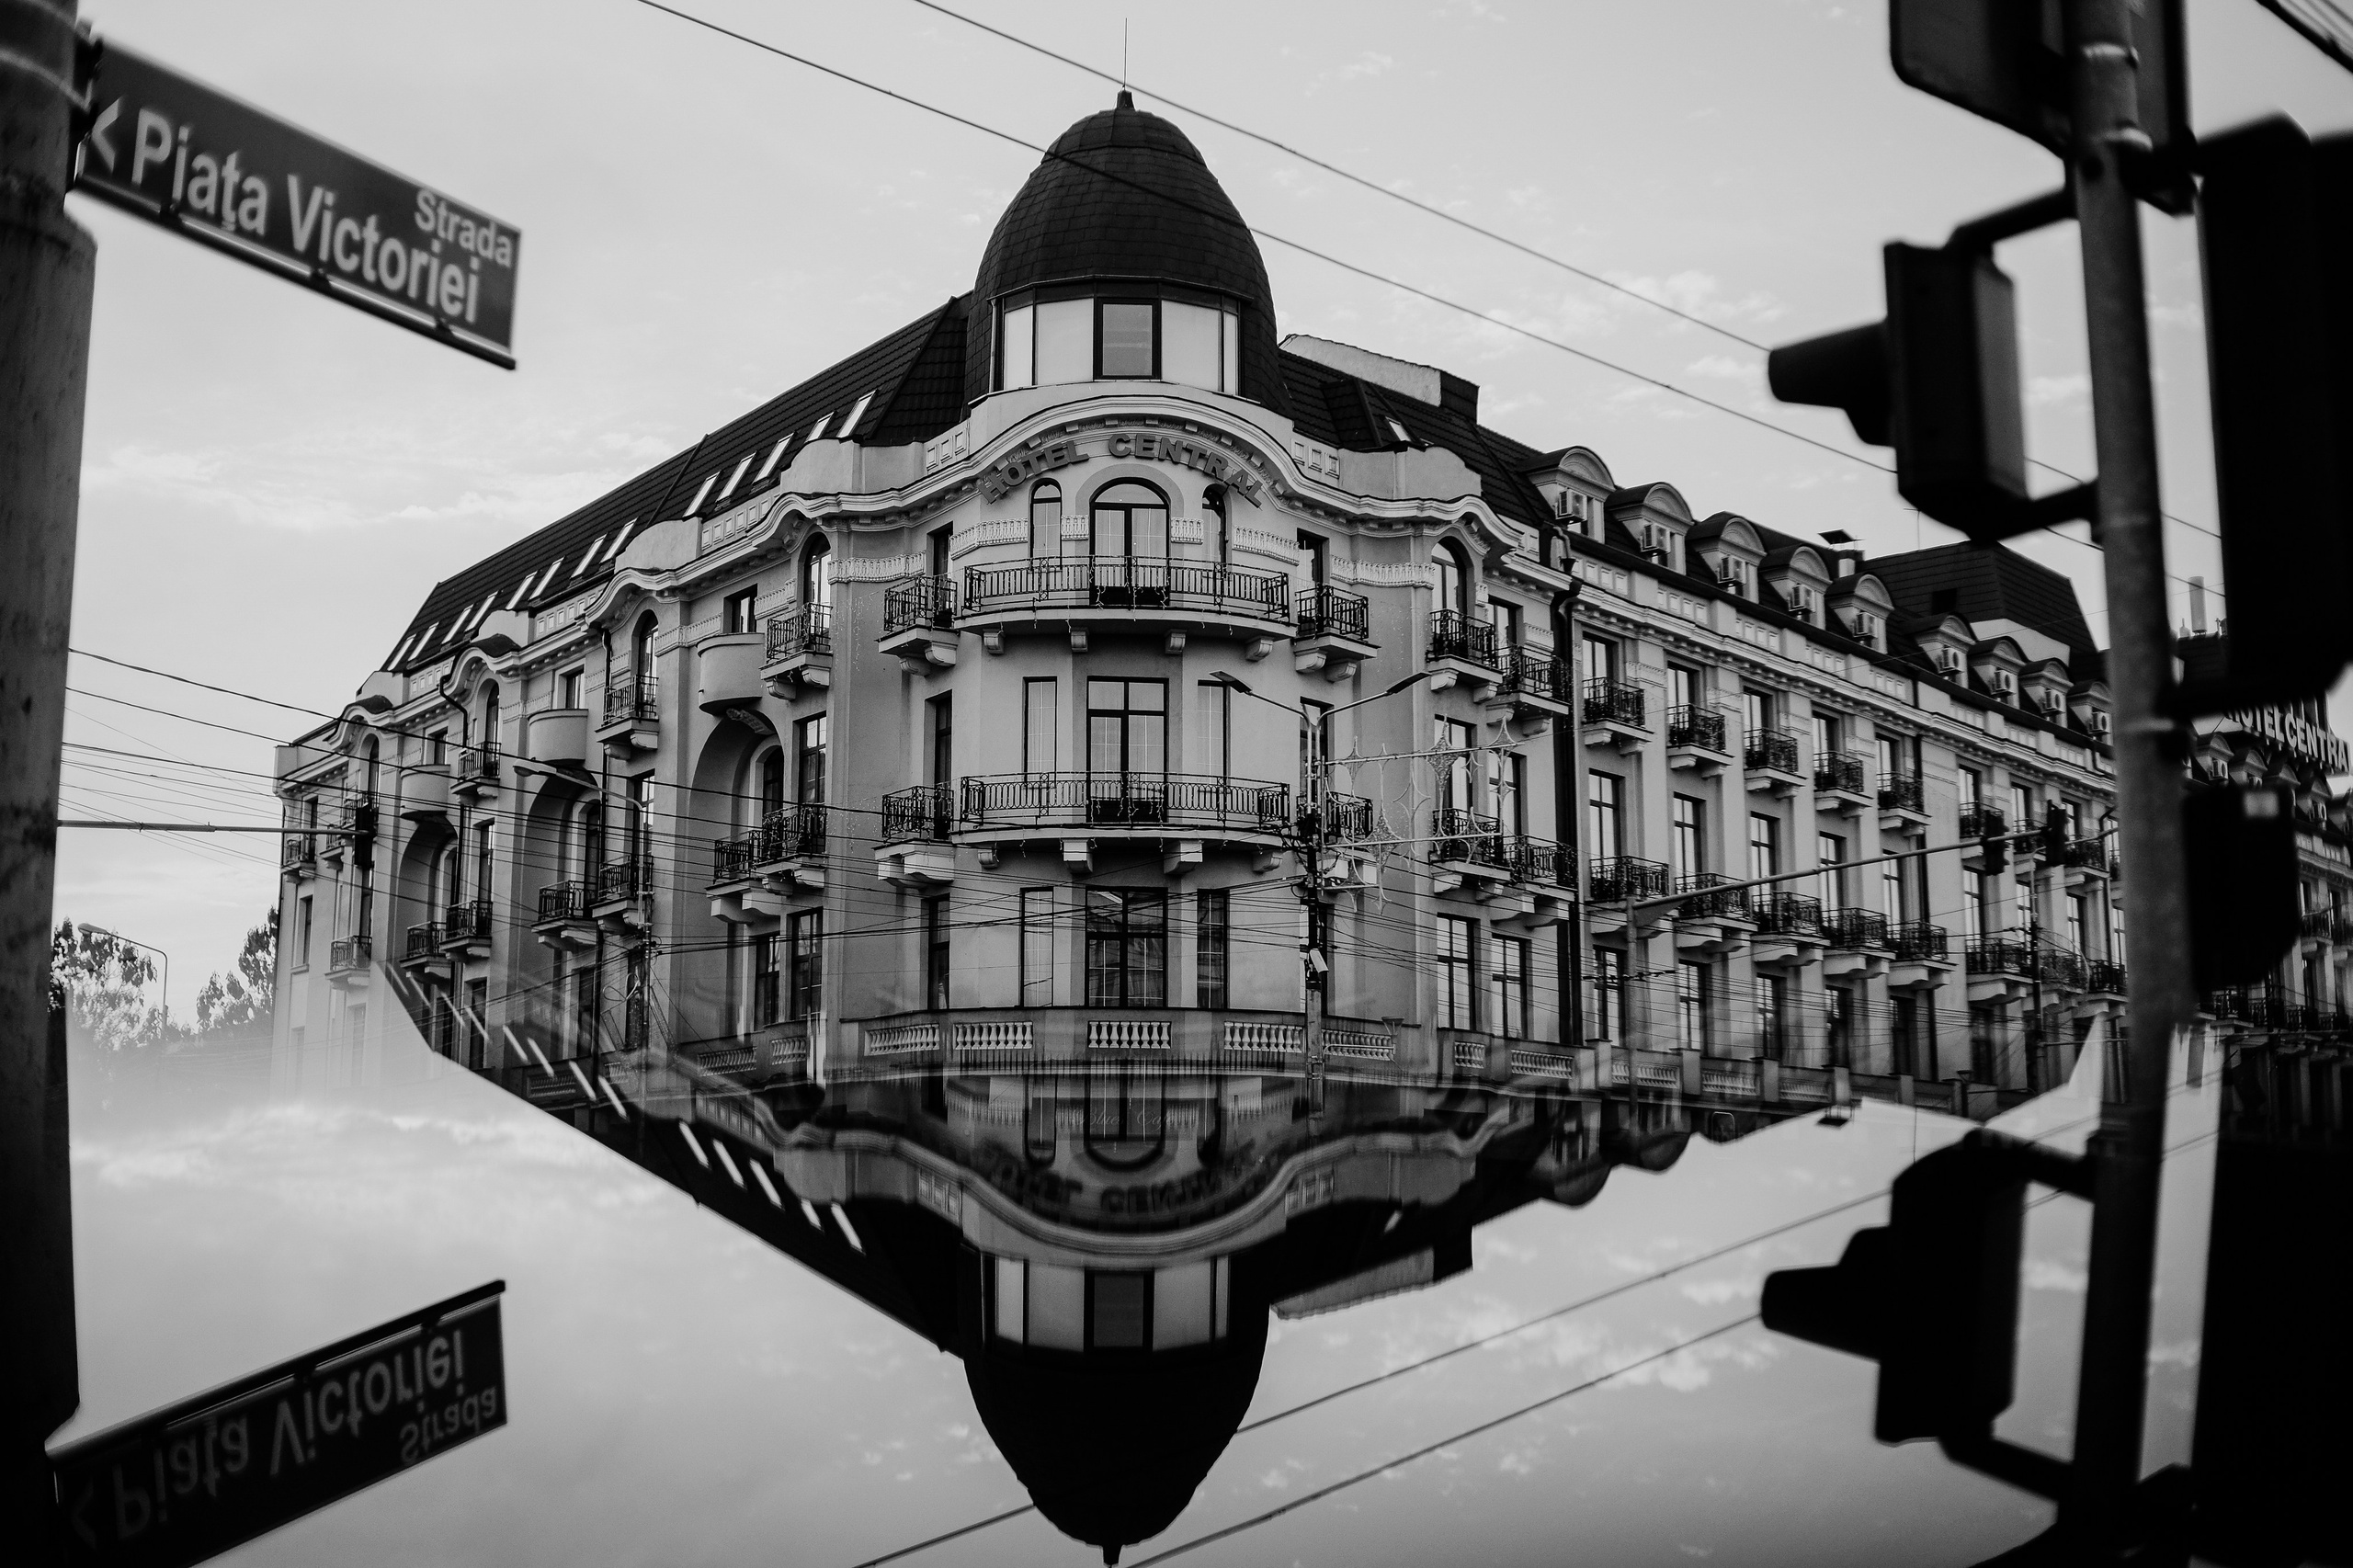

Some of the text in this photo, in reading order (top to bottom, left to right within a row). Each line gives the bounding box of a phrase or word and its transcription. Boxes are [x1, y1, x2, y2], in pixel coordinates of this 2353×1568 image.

[287, 174, 481, 323] Victoriei
[415, 188, 513, 267] Strada
[977, 432, 1266, 510] HOTEL CENTRAL
